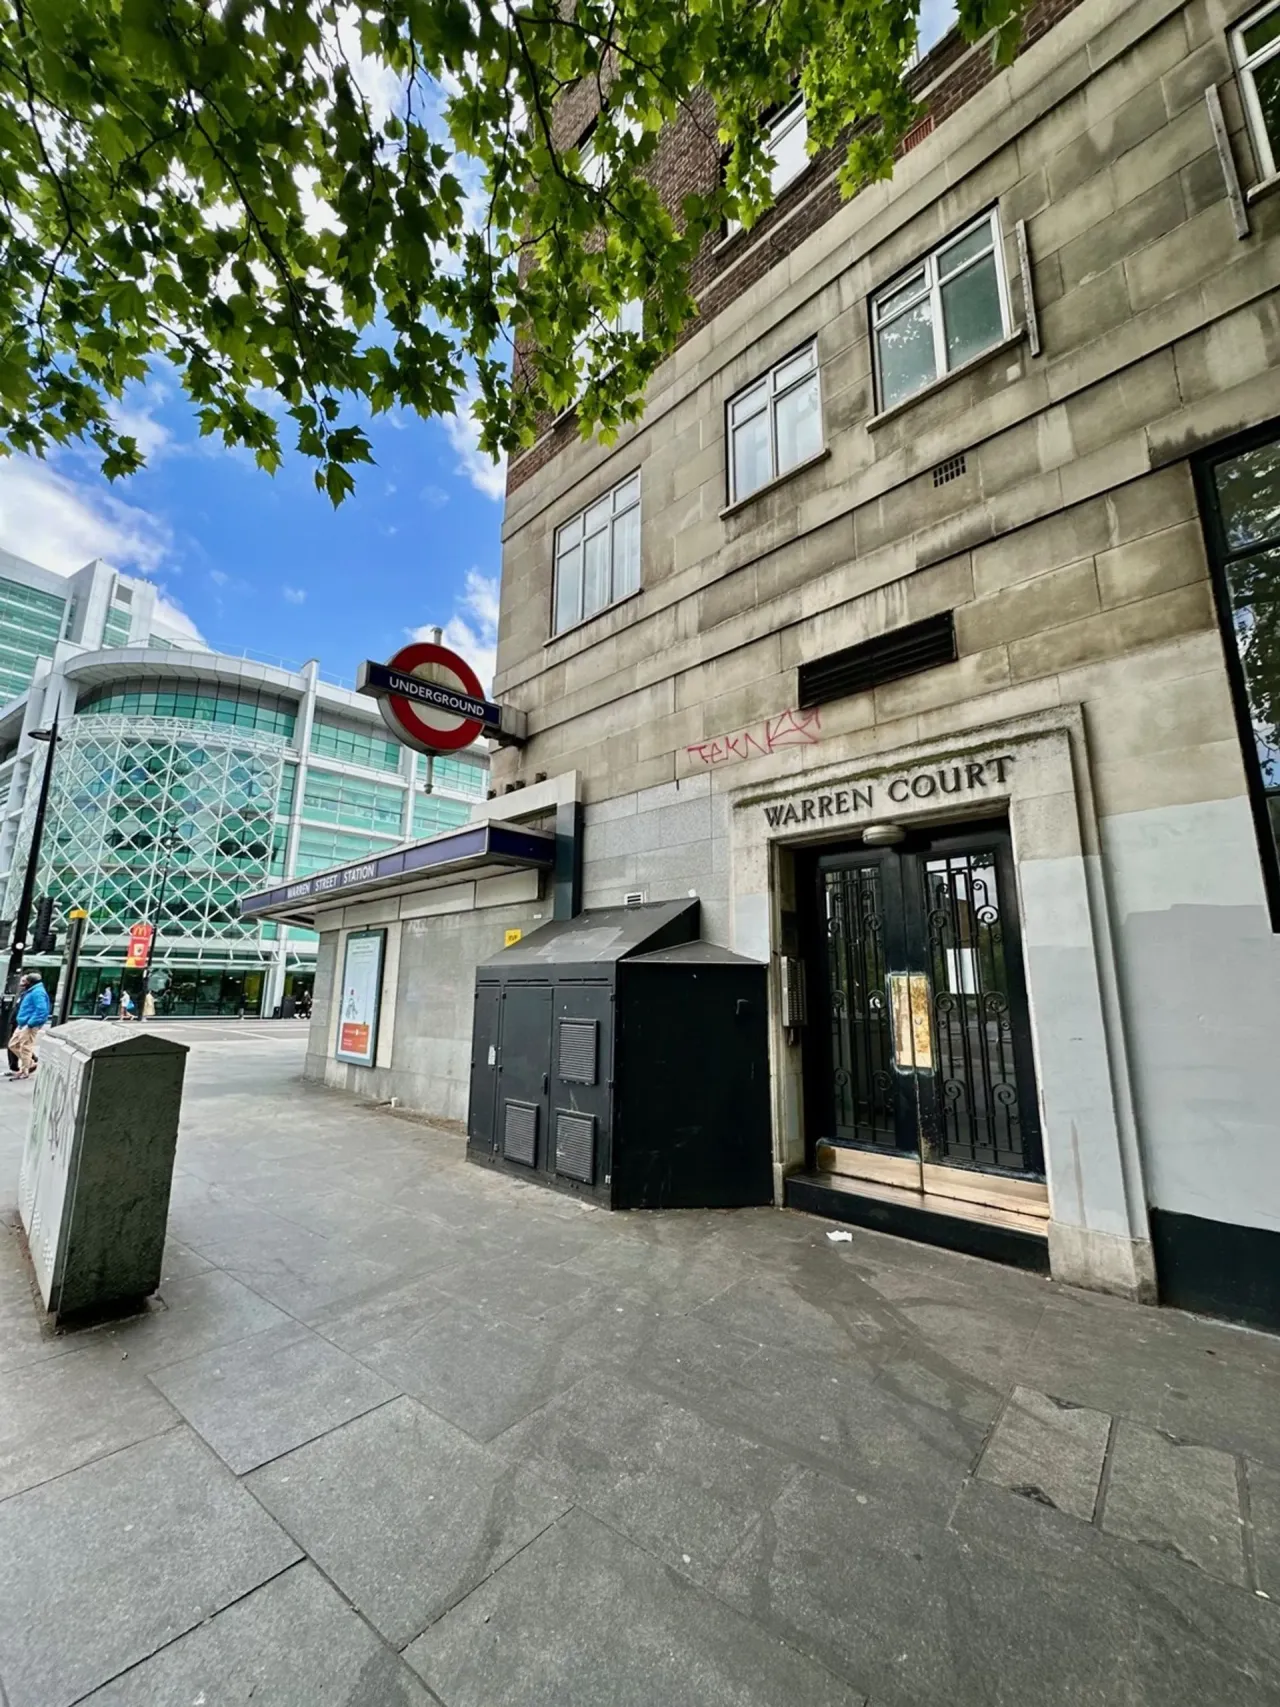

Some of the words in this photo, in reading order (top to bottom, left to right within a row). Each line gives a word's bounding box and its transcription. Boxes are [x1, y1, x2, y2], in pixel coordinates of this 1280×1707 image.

[389, 676, 484, 716] UNDERGROUND
[764, 785, 873, 828] WARREN
[887, 755, 1014, 802] COURT
[287, 882, 311, 899] WARREN
[315, 874, 338, 891] STREET
[343, 863, 375, 883] STATION
